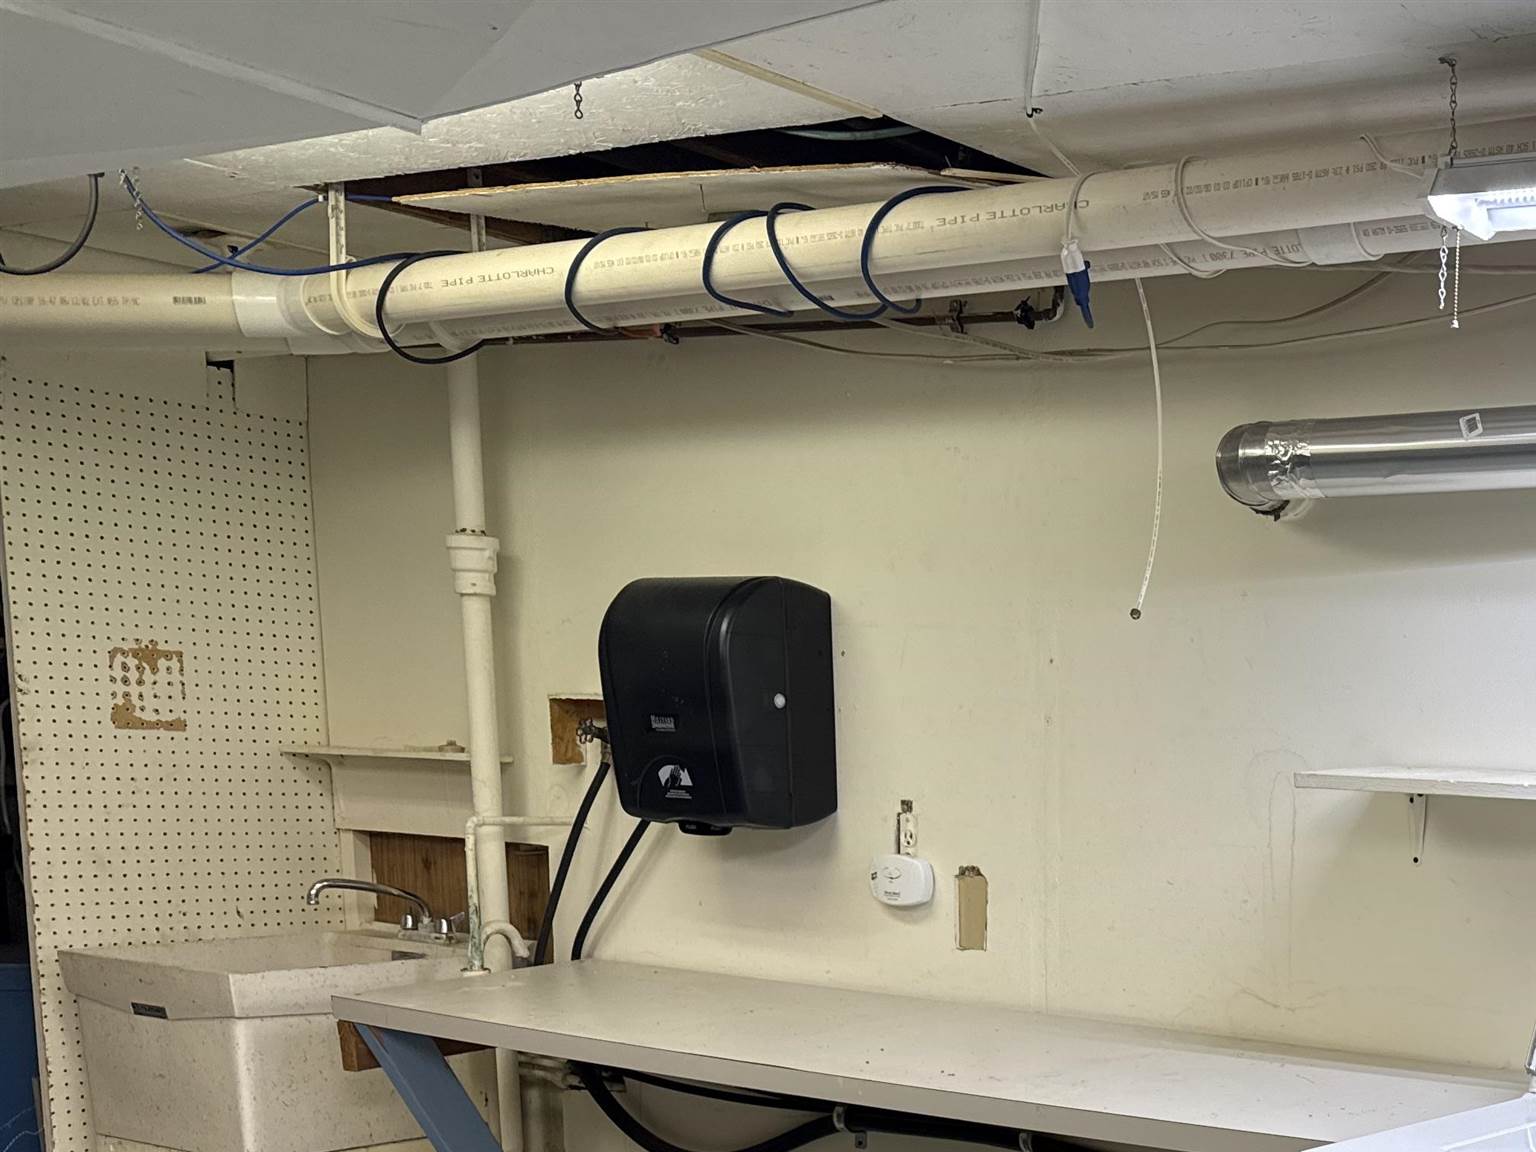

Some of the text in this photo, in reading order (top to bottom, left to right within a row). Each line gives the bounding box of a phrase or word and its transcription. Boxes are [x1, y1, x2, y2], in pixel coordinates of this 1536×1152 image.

[935, 199, 1090, 227] CARLOTTE PIPE
[440, 266, 554, 288] CHARLOTTE PIPE
